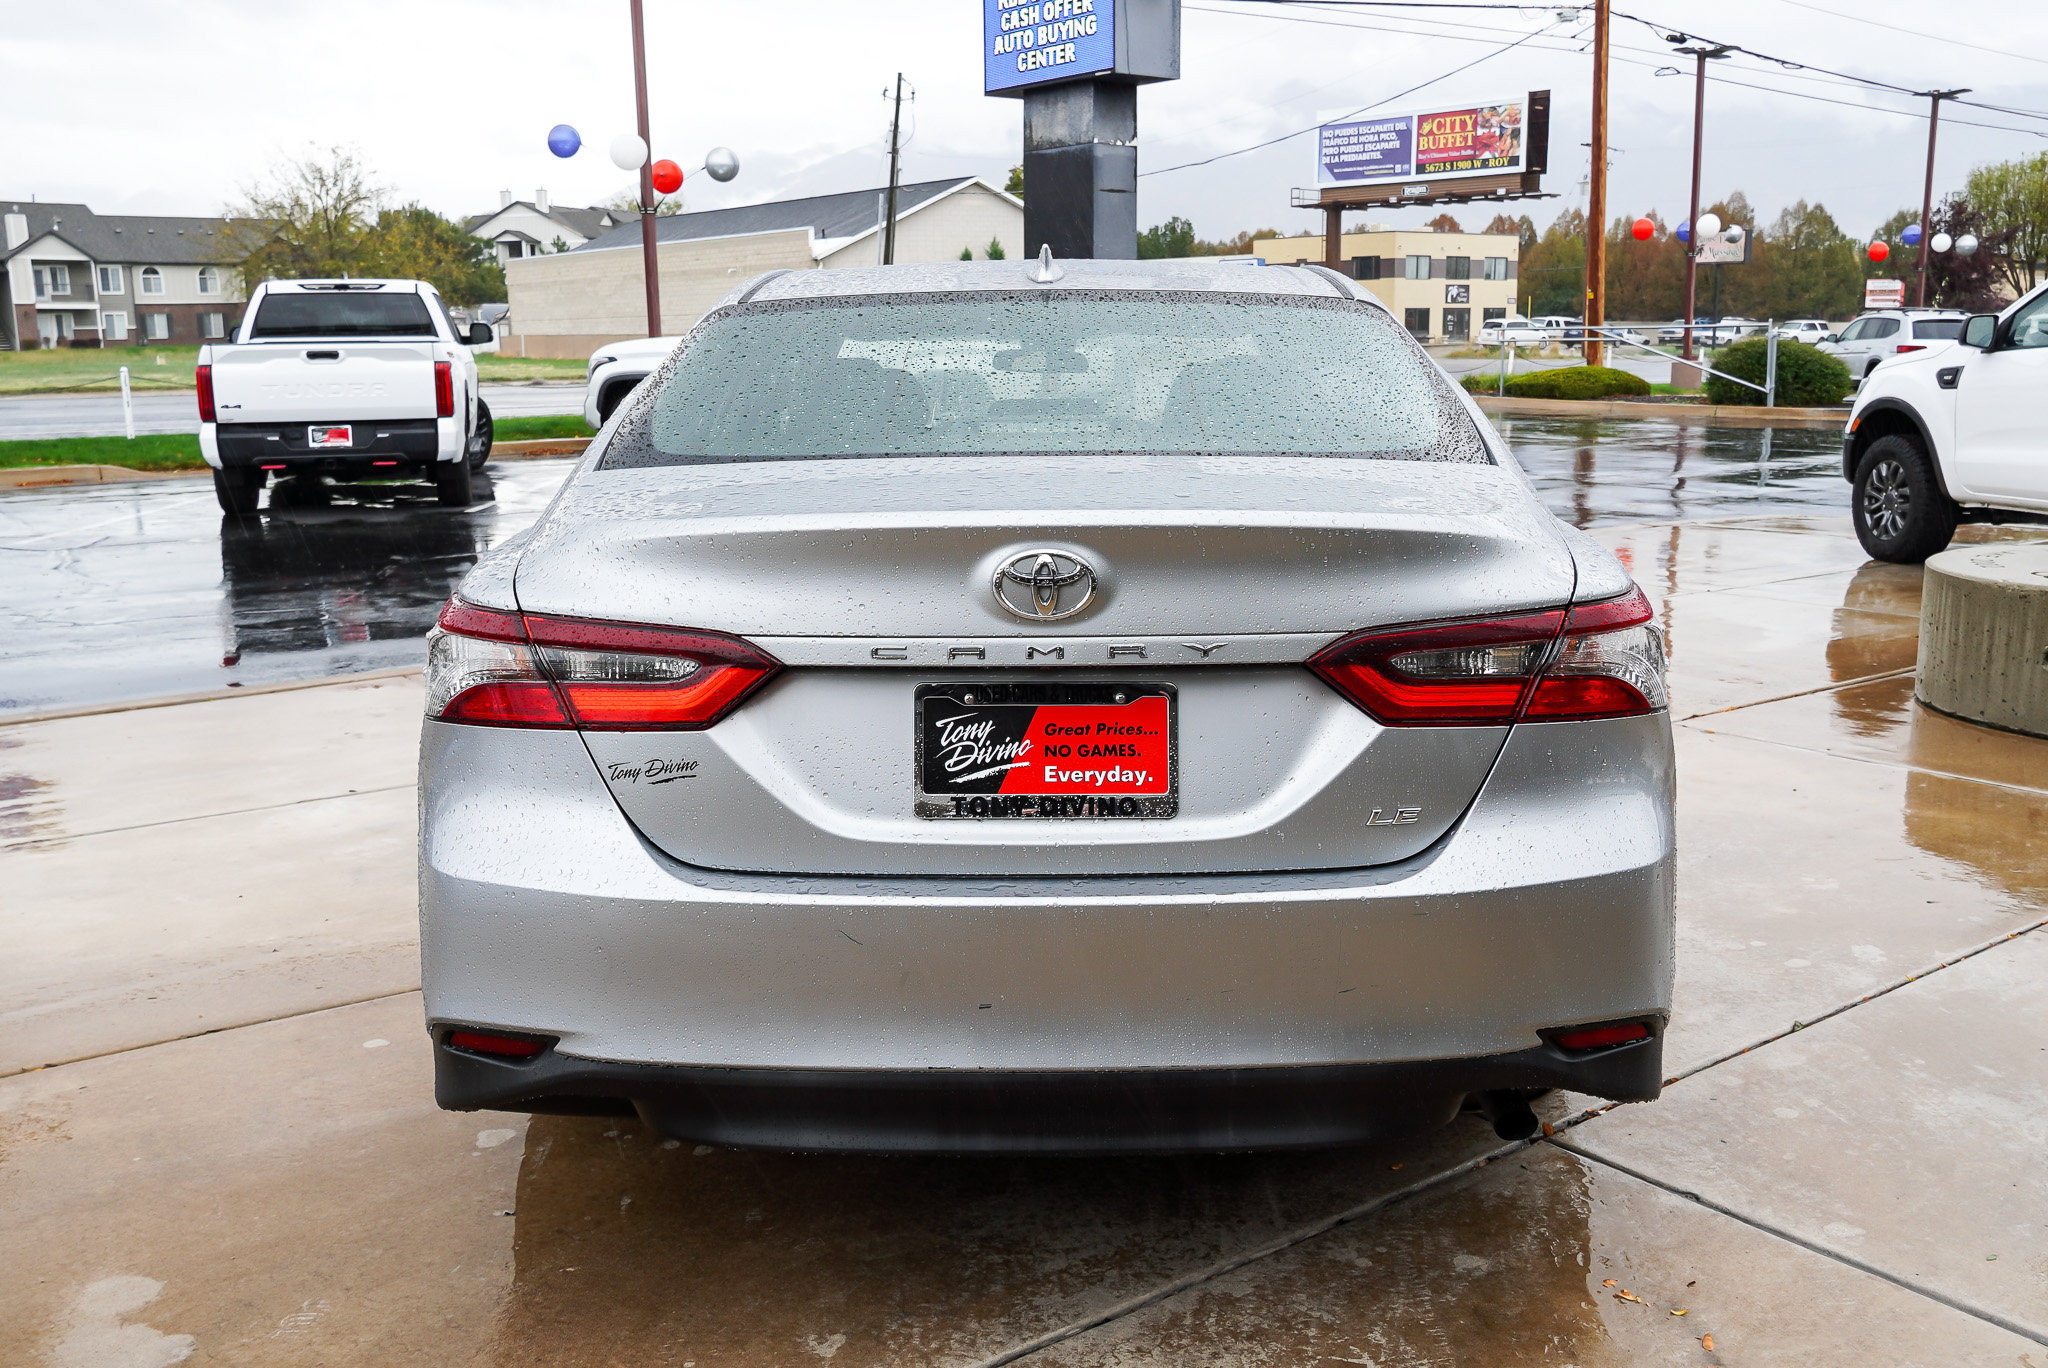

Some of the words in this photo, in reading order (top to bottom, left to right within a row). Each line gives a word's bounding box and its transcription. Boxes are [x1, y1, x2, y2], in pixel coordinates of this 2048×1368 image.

[1000, 5, 1039, 31] CASH
[1043, 0, 1094, 21] OFFER
[994, 29, 1034, 55] AUTO
[1037, 15, 1096, 45] BUYING
[1017, 42, 1076, 72] CENTER
[1323, 130, 1333, 138] NO
[1334, 127, 1358, 137] PUEDES
[1359, 124, 1394, 134] ESCAPARTE
[1395, 122, 1407, 131] DEL
[1432, 114, 1477, 134] CITY
[1322, 146, 1339, 156] PERO
[1340, 144, 1363, 154] PUEDES
[1364, 140, 1400, 151] ESCAPARTE
[1349, 136, 1358, 144] DE
[1419, 132, 1475, 150] BUFFET
[1322, 156, 1330, 164] DE
[1331, 155, 1339, 163] LA
[1425, 162, 1444, 173] 5673
[1445, 162, 1451, 171] S
[1453, 160, 1472, 170] 1900
[1473, 160, 1482, 169] W
[260, 383, 388, 399] TUNDRA
[871, 643, 1228, 660] CAMRY
[936, 712, 995, 748] Tony
[1044, 722, 1090, 736] Great
[1095, 722, 1159, 736] Prices...
[936, 736, 1034, 771] Divino
[1044, 743, 1072, 757] NO
[1077, 743, 1142, 757] GAMES.
[608, 761, 643, 784] Tony
[645, 758, 700, 778] Divino
[1044, 765, 1152, 786] Everyday.
[950, 796, 1029, 817] TONY
[1039, 796, 1139, 817] DIVINO
[1366, 807, 1422, 826] LE
